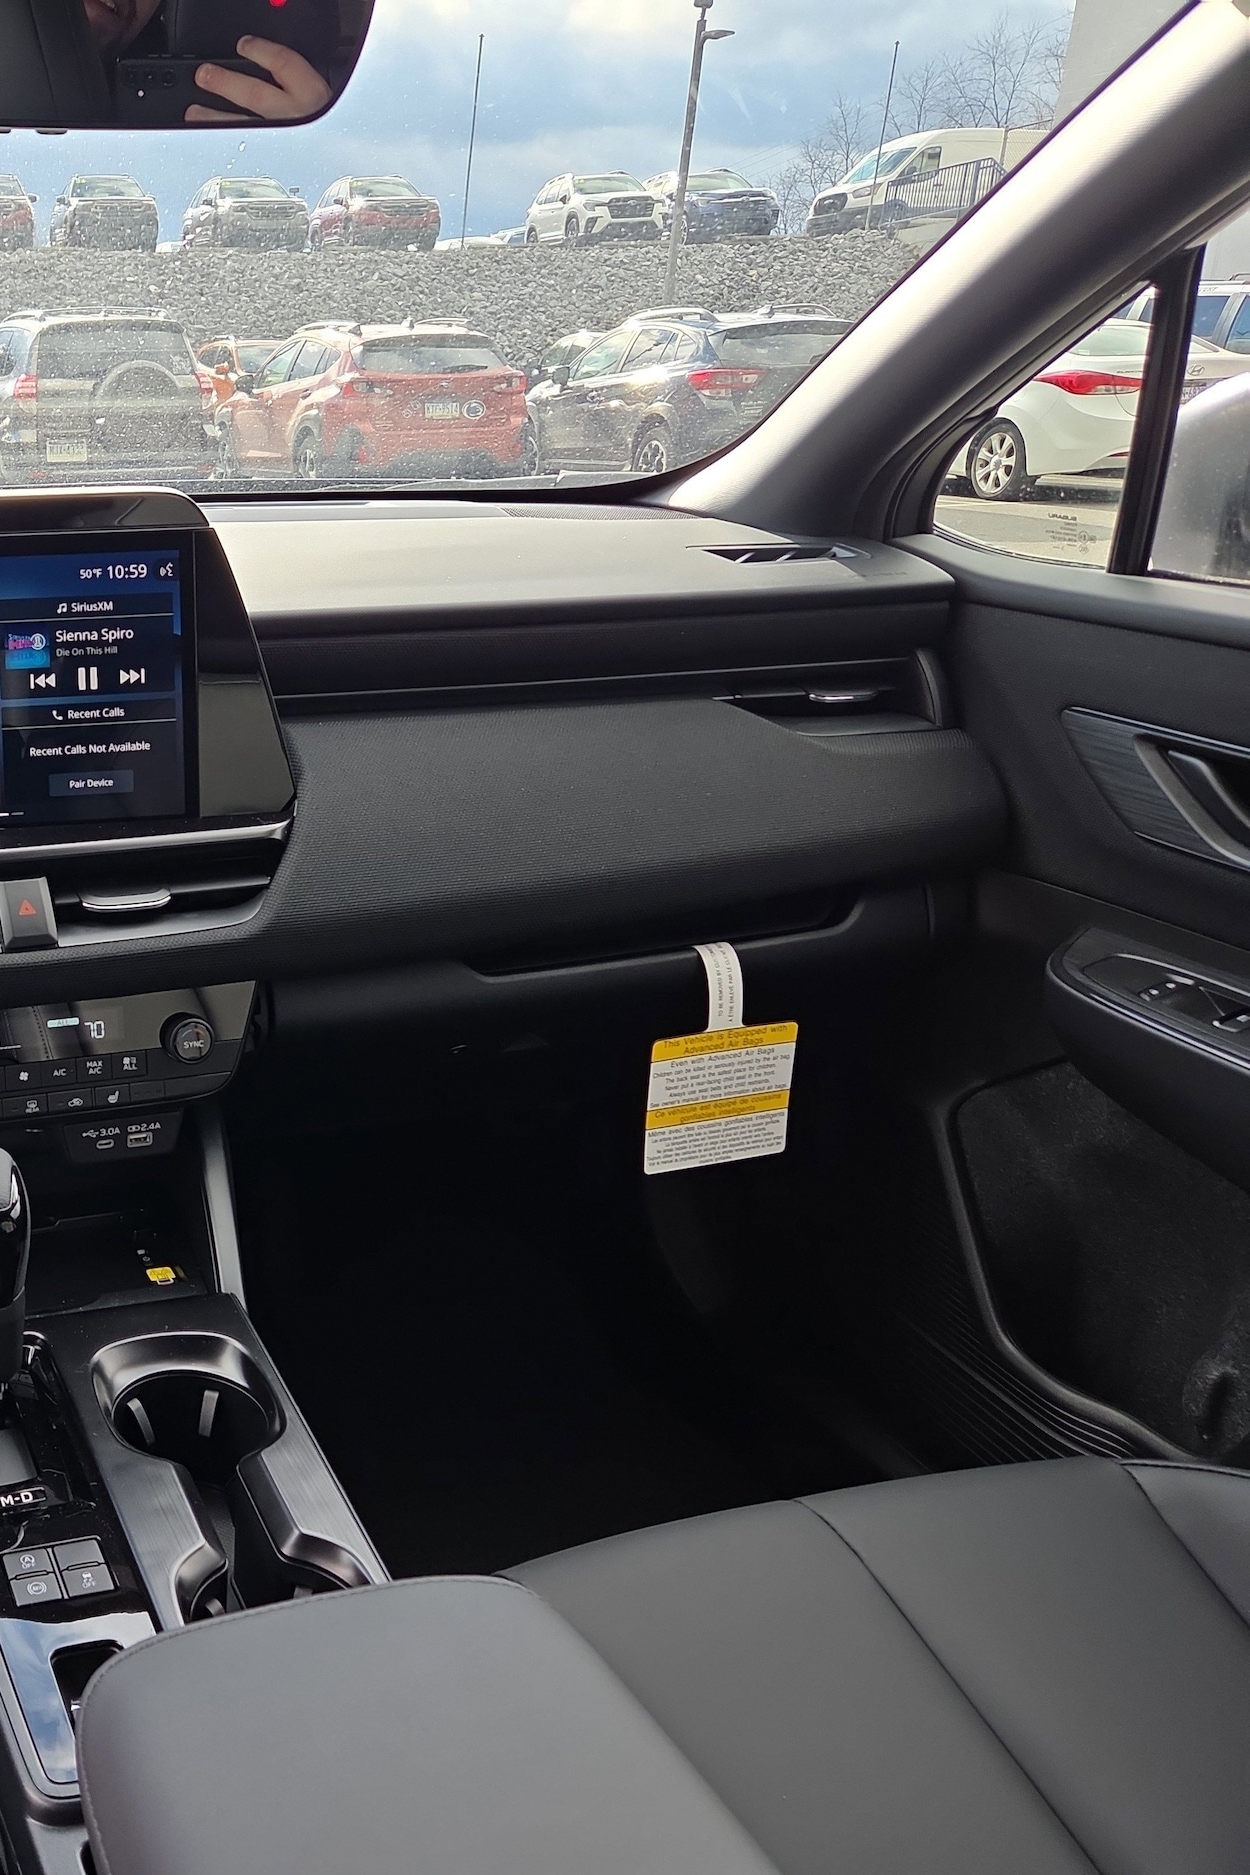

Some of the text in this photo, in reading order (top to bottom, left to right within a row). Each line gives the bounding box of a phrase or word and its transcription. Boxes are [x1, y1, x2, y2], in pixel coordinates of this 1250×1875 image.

[79, 564, 148, 579] 50°F 10:59
[71, 601, 114, 613] SiriusXM
[55, 627, 135, 643] Sienna Spiro
[56, 645, 118, 657] Die On This Hill
[68, 707, 125, 719] Recent Calls
[30, 740, 151, 757] Recent Calls Not Available
[69, 778, 114, 789] Pair Device
[84, 1021, 105, 1039] 70
[663, 1040, 680, 1049] This
[683, 1034, 714, 1045] Vehicle
[728, 1027, 767, 1039] Equipped
[771, 1025, 788, 1033] with
[183, 1039, 205, 1049] SYNC
[683, 1042, 725, 1055] Advanced
[742, 1037, 763, 1046] Bags
[86, 1060, 103, 1068] MAX
[671, 1060, 688, 1068] Even
[708, 1052, 742, 1062] Advanced
[53, 1068, 68, 1077] A/C
[88, 1067, 103, 1075] A/C
[122, 1062, 138, 1071] ALL
[100, 1127, 121, 1137] 3.0A
[140, 1121, 162, 1132] 2.4A
